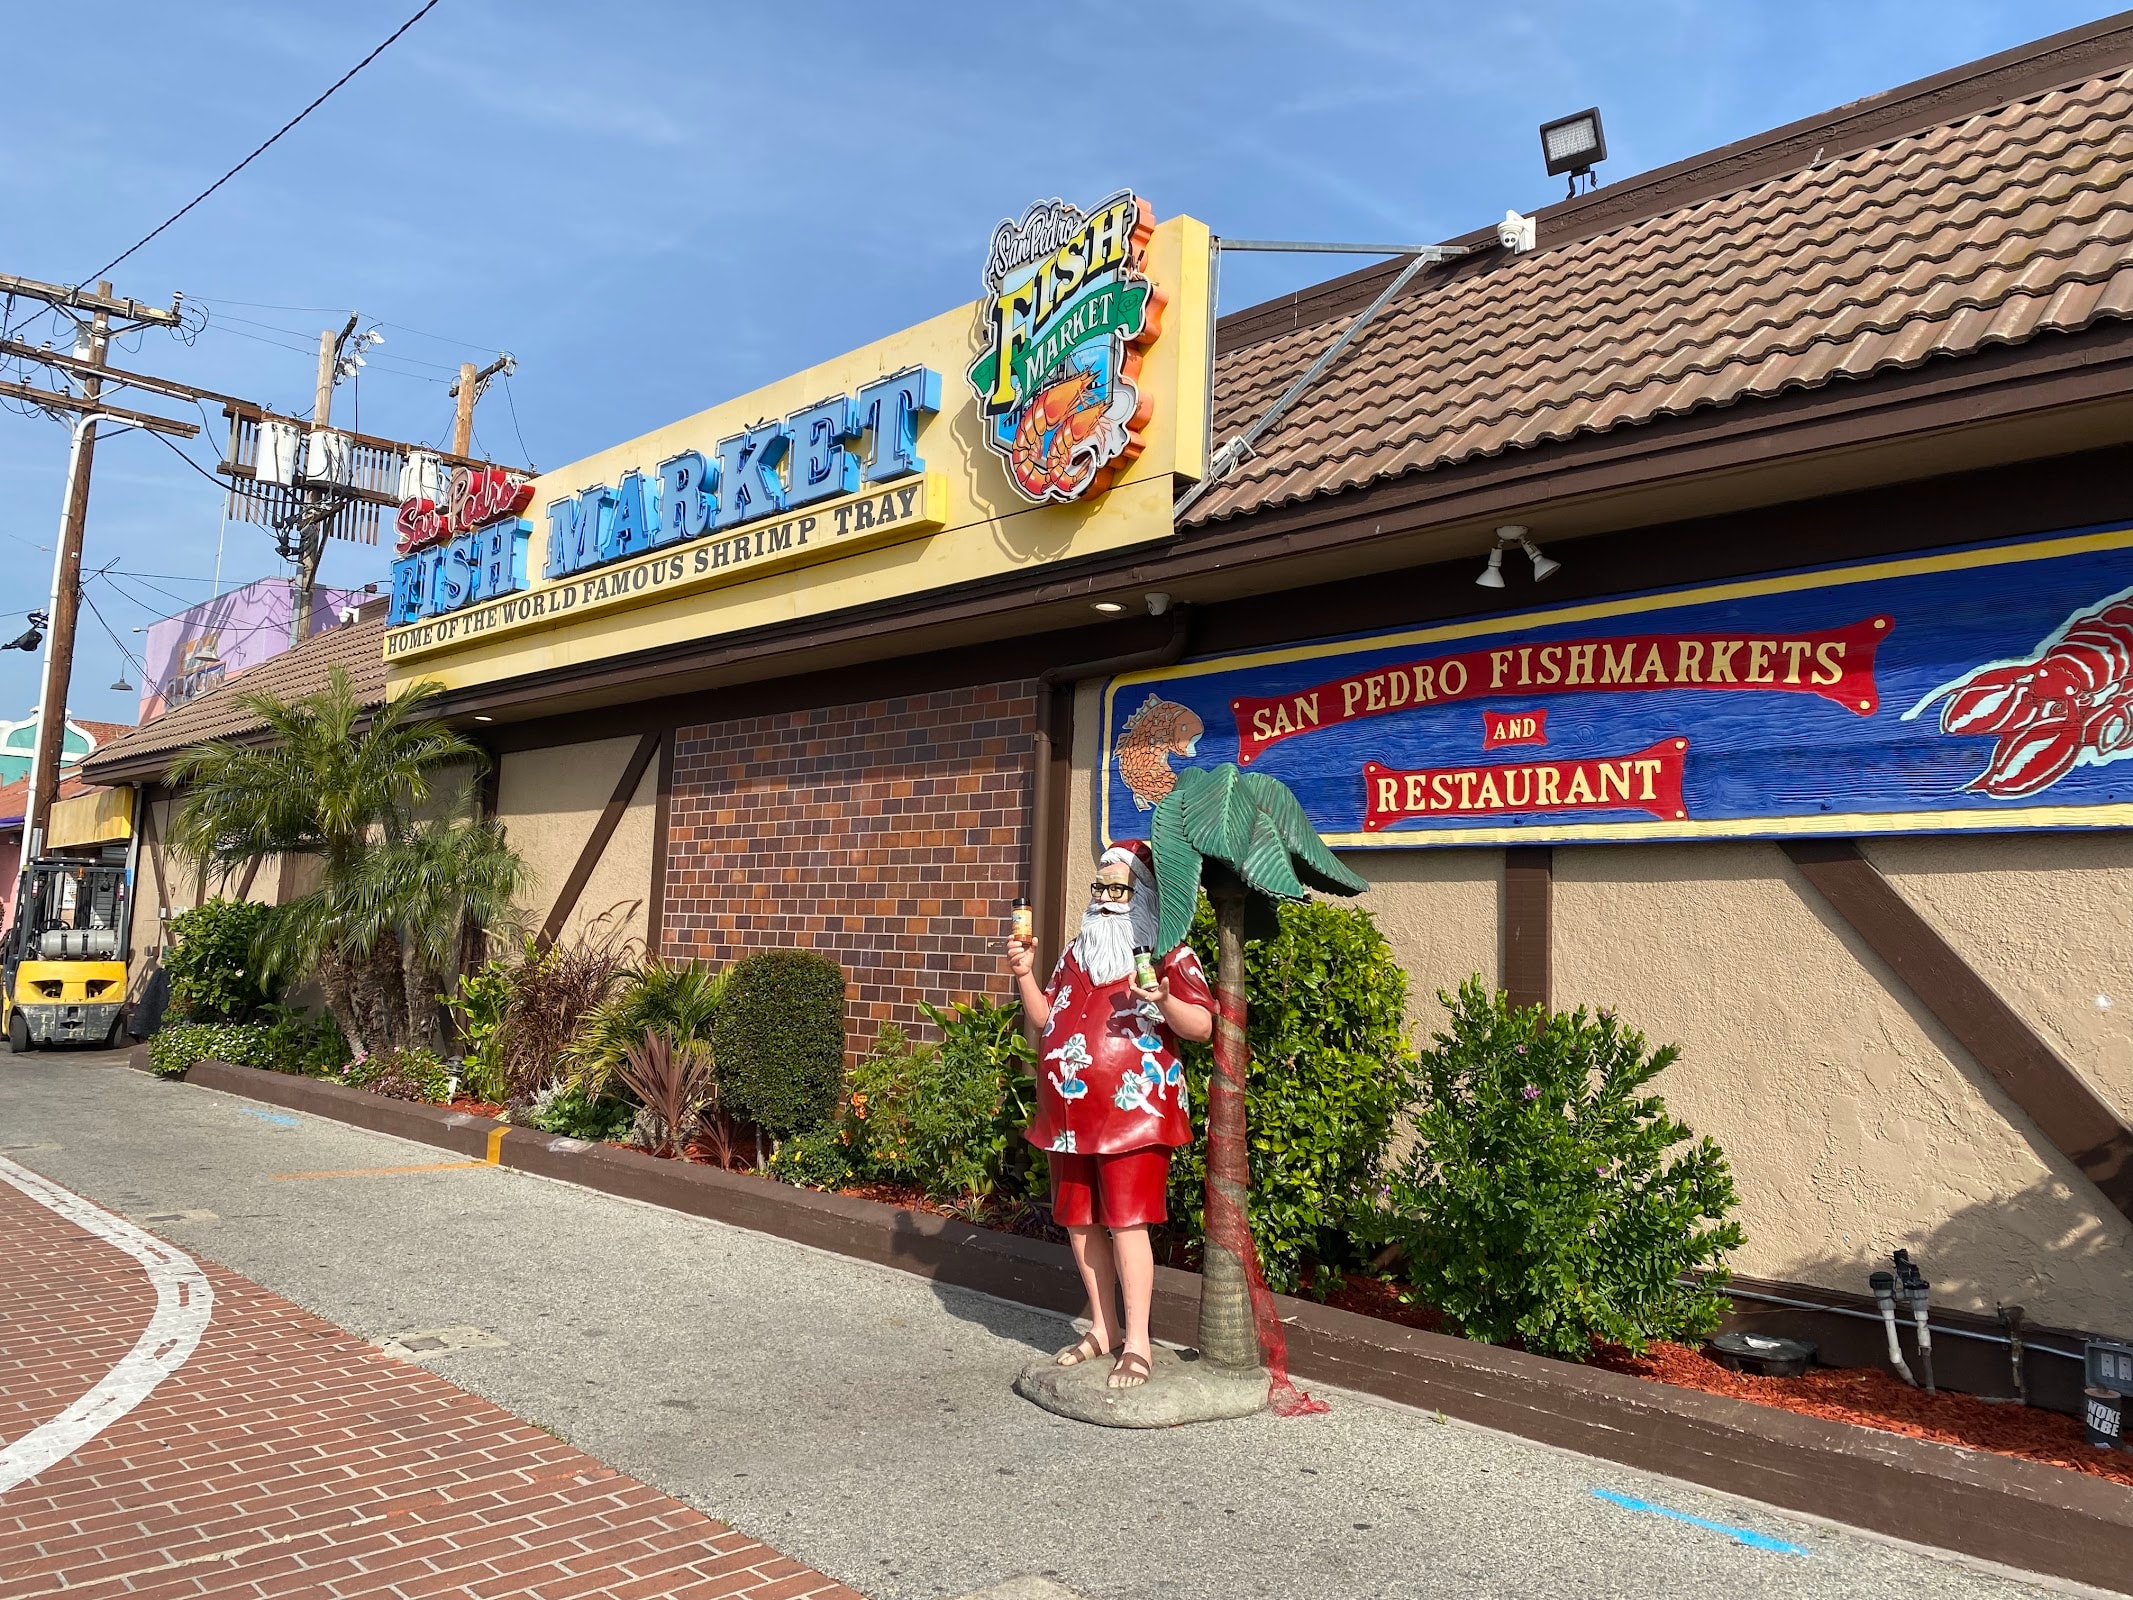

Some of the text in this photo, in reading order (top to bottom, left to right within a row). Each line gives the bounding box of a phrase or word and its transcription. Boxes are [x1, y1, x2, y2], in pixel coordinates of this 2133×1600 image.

[995, 209, 1079, 279] San Pedro
[989, 200, 1129, 408] FISH
[1025, 292, 1115, 392] MARKET
[385, 363, 939, 628] FISH MARKET
[393, 465, 524, 554] San Pedro
[386, 486, 918, 656] HOME OF THE WORLD FAMOUS SHRIMP TRAY
[1252, 640, 1847, 743] SAN PEDRO FISHMARKETS
[1492, 717, 1537, 741] AND
[1376, 759, 1662, 814] RESTAURANT
